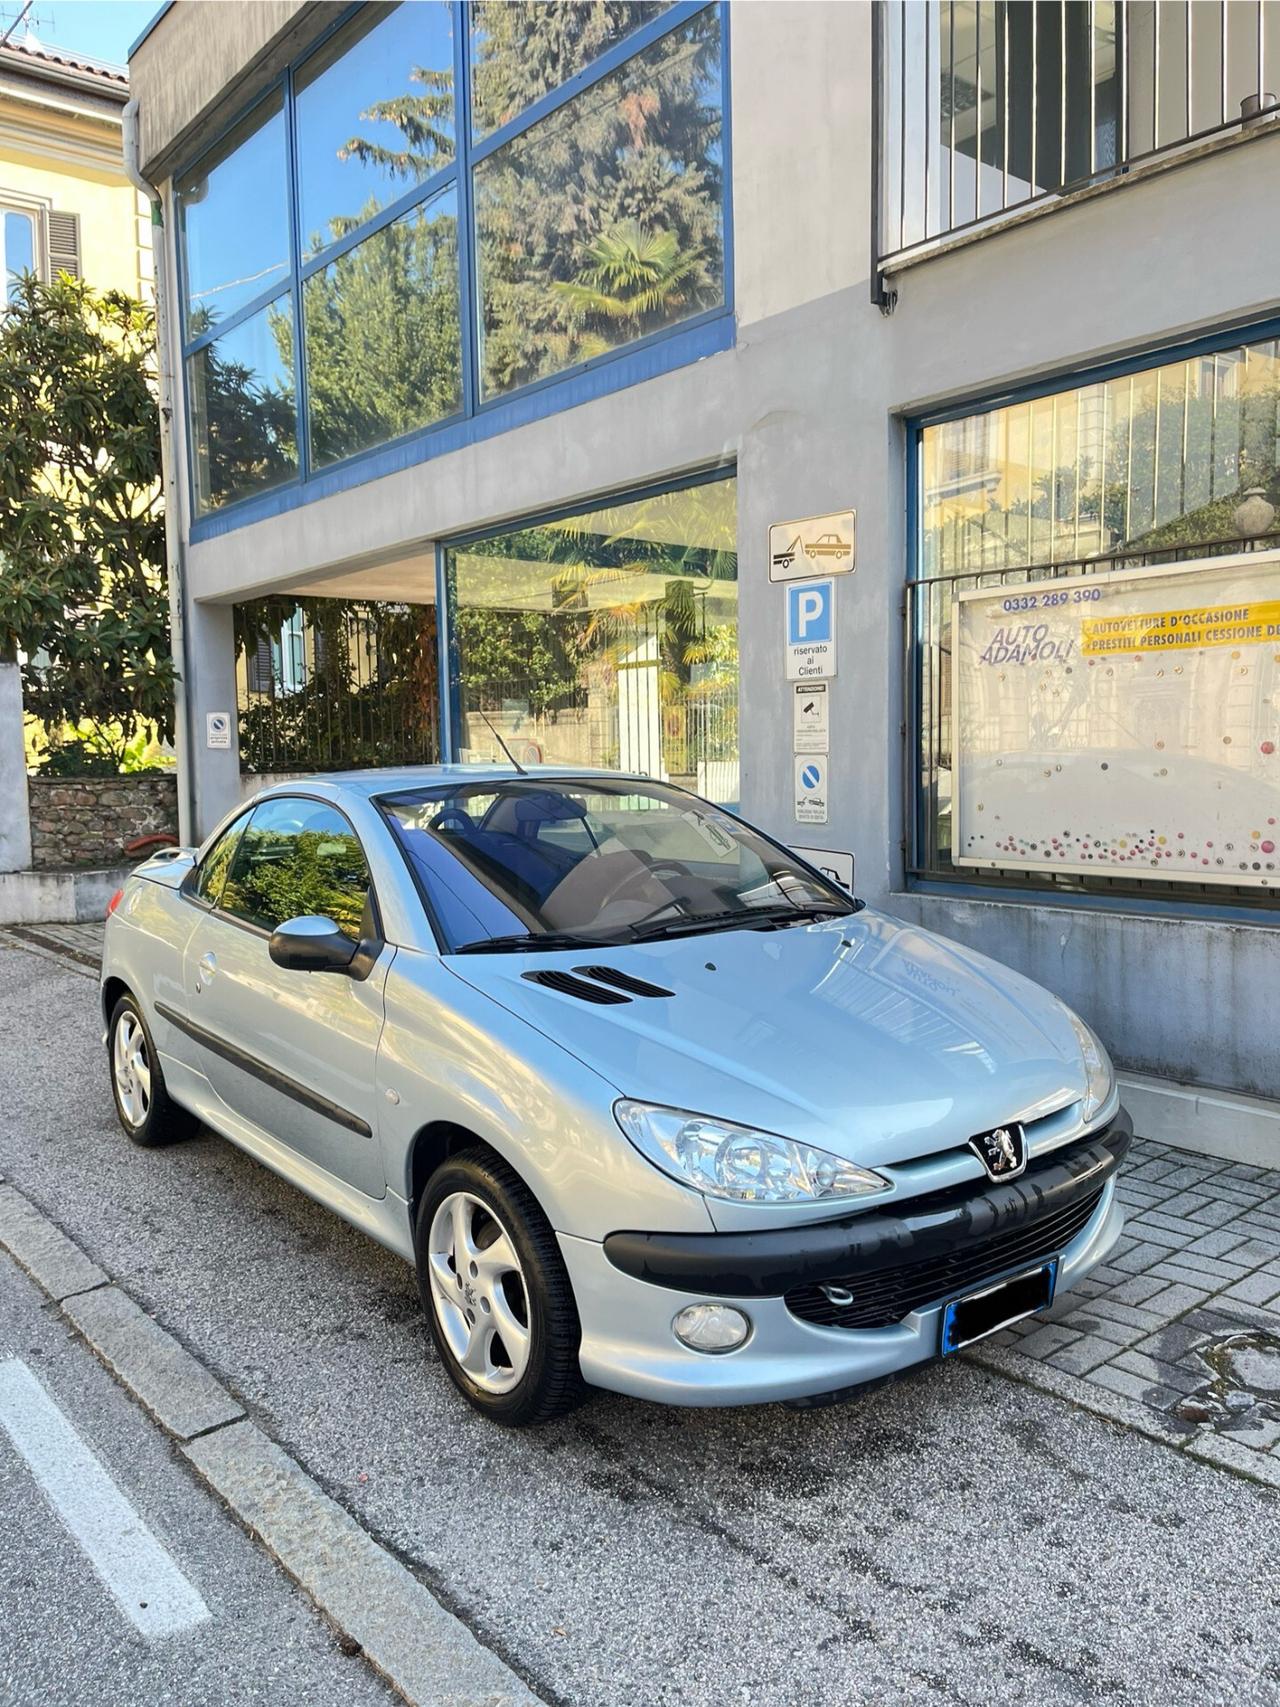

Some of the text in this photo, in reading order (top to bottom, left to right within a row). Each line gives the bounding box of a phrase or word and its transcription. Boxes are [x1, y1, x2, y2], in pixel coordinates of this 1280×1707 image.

[1003, 588, 1101, 611] 0332 289 390
[798, 591, 824, 637] P
[1170, 608, 1249, 627] D'OCCASIONE
[991, 624, 1049, 646] AUTO
[1092, 636, 1136, 650] PRESTITI
[1140, 631, 1201, 646] PERSONALI
[1205, 626, 1262, 641] CESSIONE
[793, 644, 828, 656] riservato
[807, 655, 814, 665] ai
[980, 640, 1074, 665] ADAMOLI
[798, 666, 824, 676] Clienti
